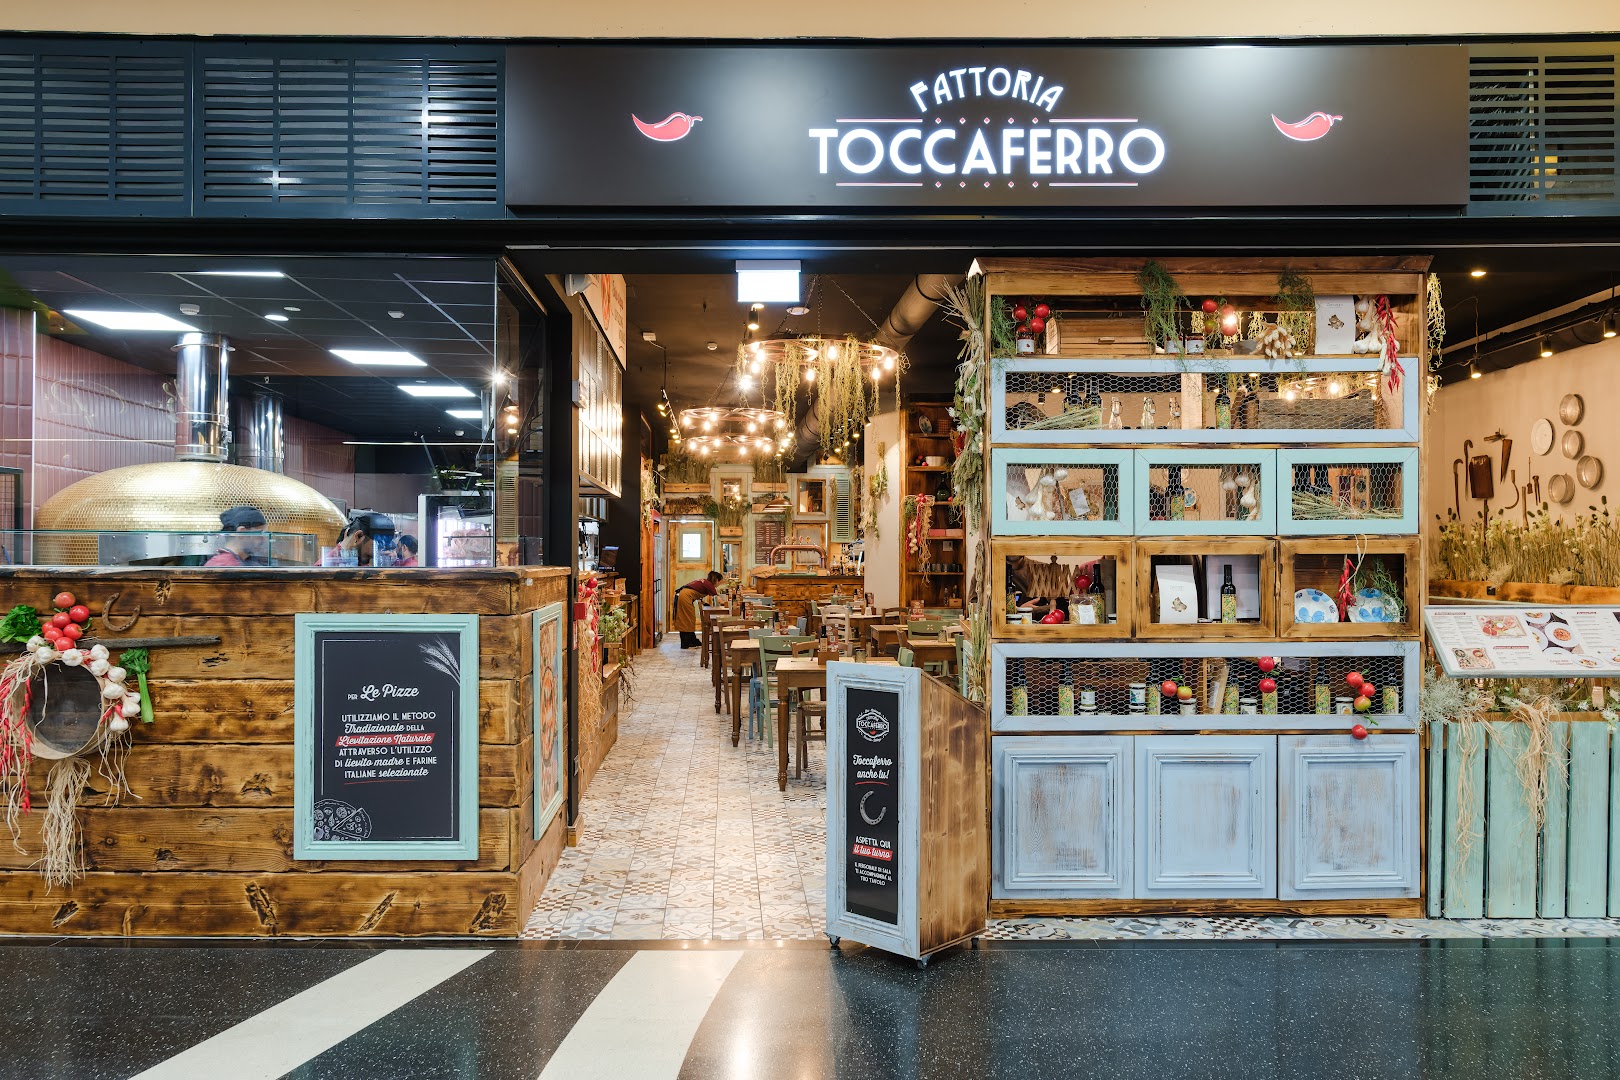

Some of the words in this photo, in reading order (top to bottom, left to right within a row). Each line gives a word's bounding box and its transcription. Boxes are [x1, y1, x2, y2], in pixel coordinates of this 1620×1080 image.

[909, 66, 1064, 113] FATTORIA
[808, 127, 1166, 175] TOCCAFERRO
[360, 684, 381, 702] Le
[382, 683, 420, 698] Pizze
[341, 713, 390, 722] UTILIZZIAMO
[392, 712, 399, 721] IL
[401, 711, 436, 721] METODO
[344, 723, 405, 734] Tradizionale
[338, 735, 393, 747] Lievitazione
[393, 733, 433, 745] Naturale
[339, 747, 388, 757] ATTRAVERSO
[390, 745, 432, 755] L'UTILIZZO
[334, 760, 343, 768] DI
[344, 757, 373, 768] lievito
[373, 757, 405, 767] madre
[412, 756, 437, 765] FARINE
[852, 754, 893, 769] Toccaferro
[344, 769, 376, 779] ITALIANE
[378, 766, 429, 778] selezionate
[856, 769, 878, 779] anche
[855, 835, 879, 847] ASPETTA
